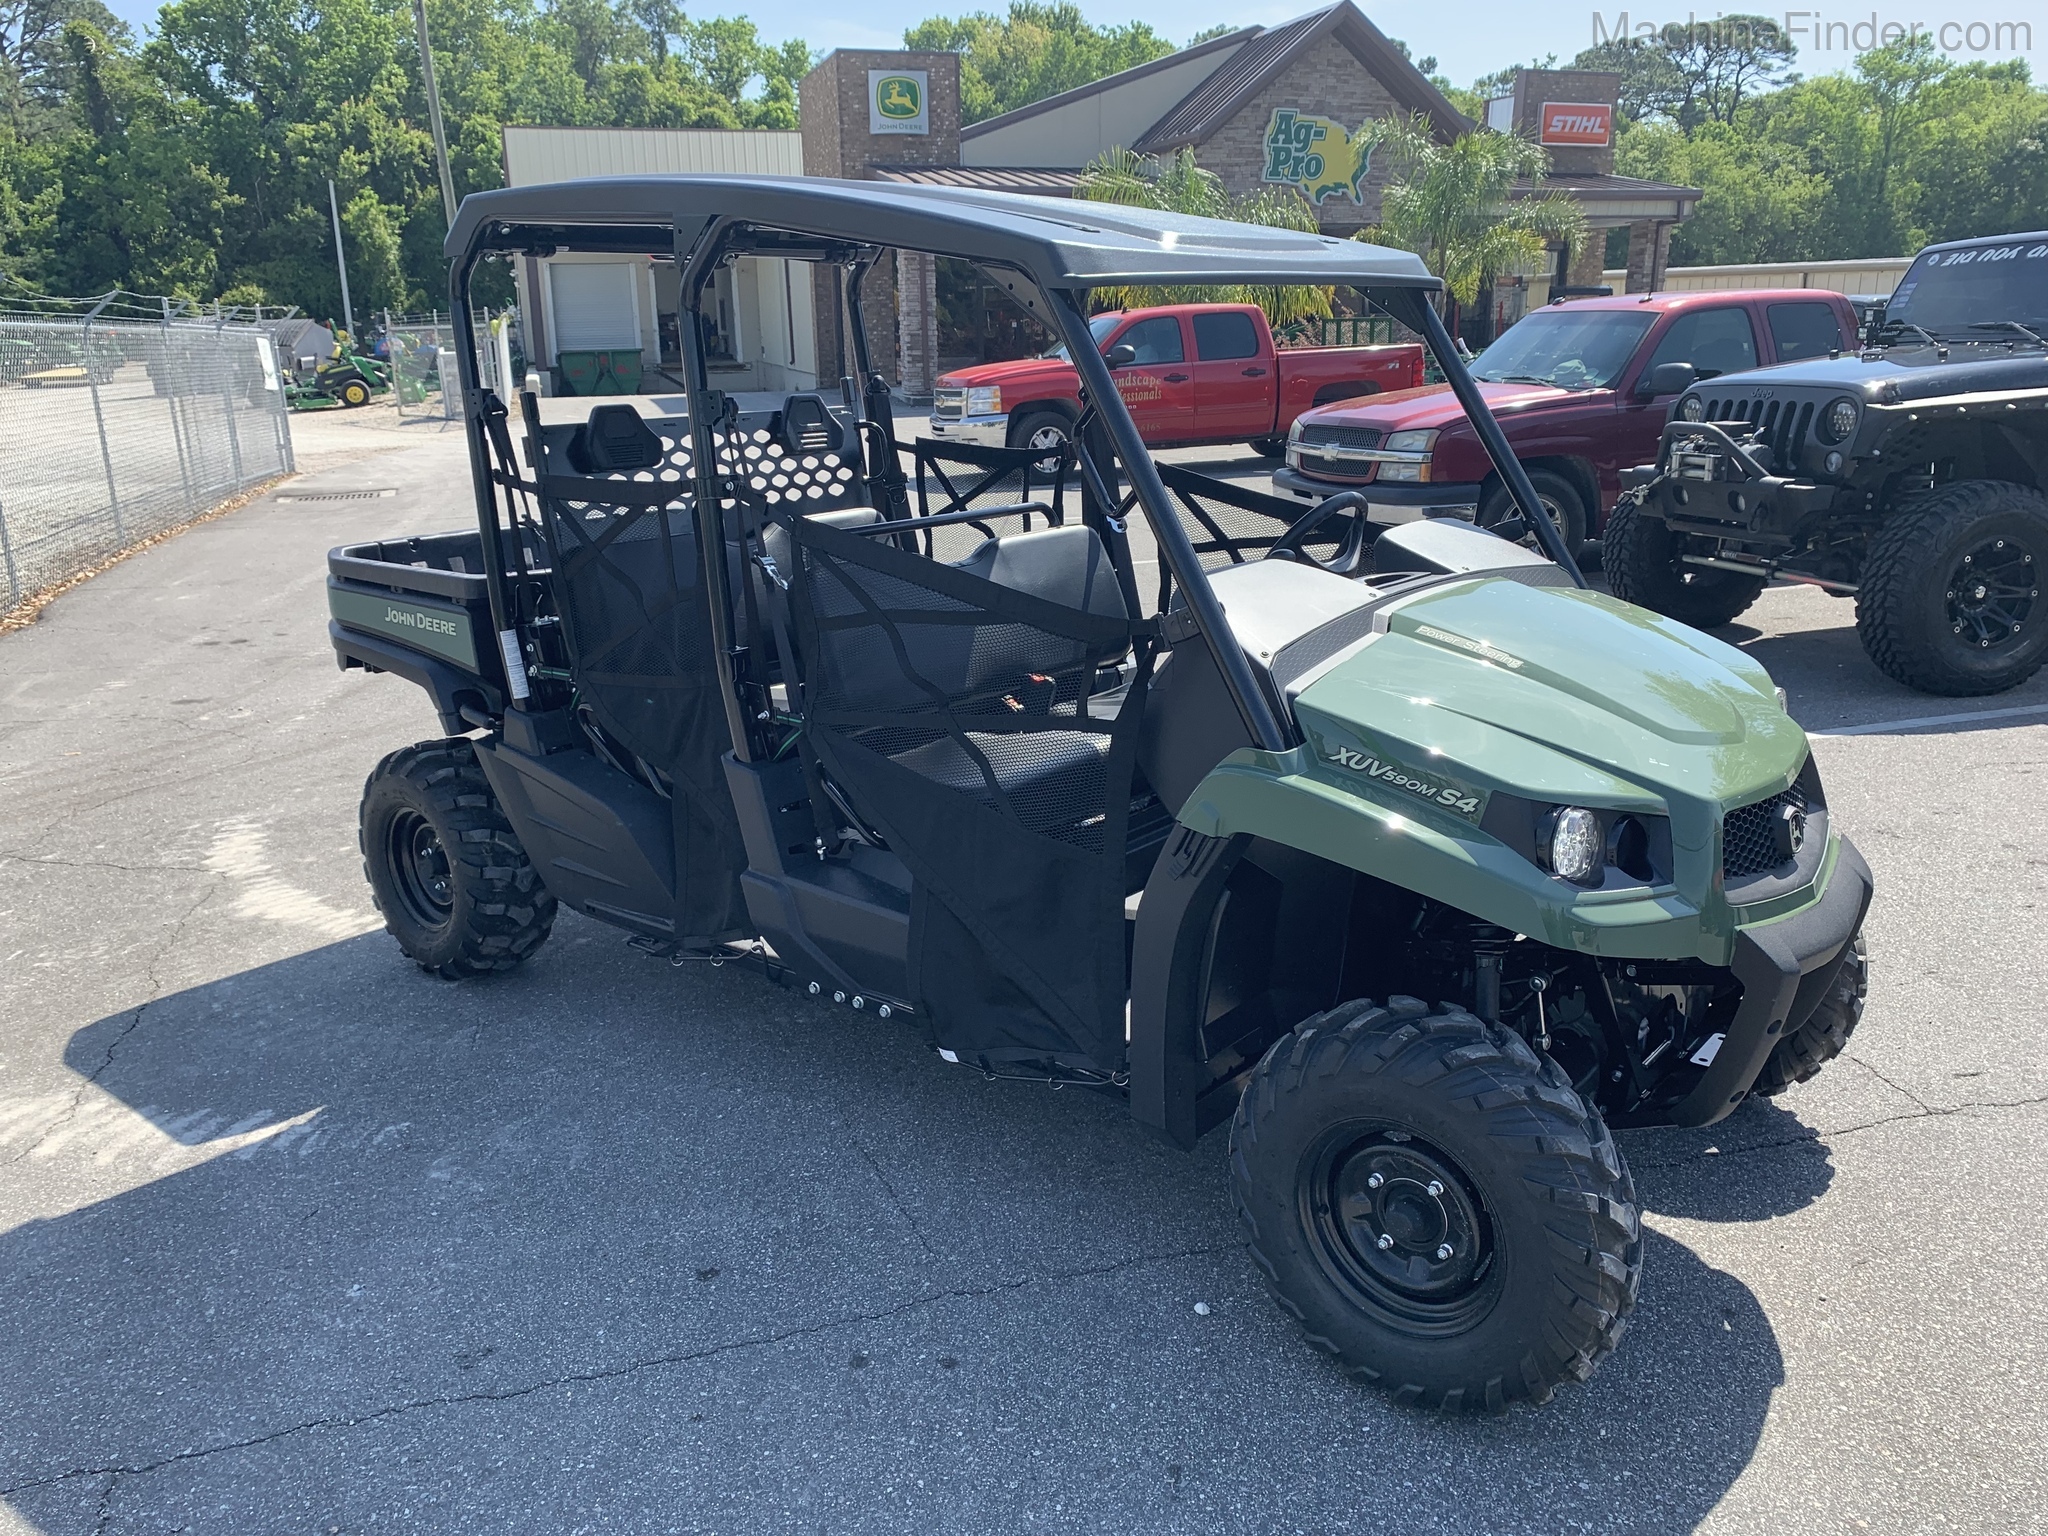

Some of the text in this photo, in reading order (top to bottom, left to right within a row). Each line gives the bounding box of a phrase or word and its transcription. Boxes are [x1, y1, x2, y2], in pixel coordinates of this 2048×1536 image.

[877, 122, 923, 131] JOHN DEERE
[1548, 115, 1606, 133] STIHL
[1266, 146, 1325, 180] Pro
[1940, 250, 1978, 267] DIE
[1976, 245, 2024, 262] YOU
[1113, 371, 1162, 388] andscape
[1120, 385, 1162, 402] fessionals
[1750, 387, 1774, 400] Jeep
[384, 606, 457, 636] JOHN DEERE
[1415, 625, 1524, 669] Power Steering
[1329, 746, 1480, 814] XUV590M S4
